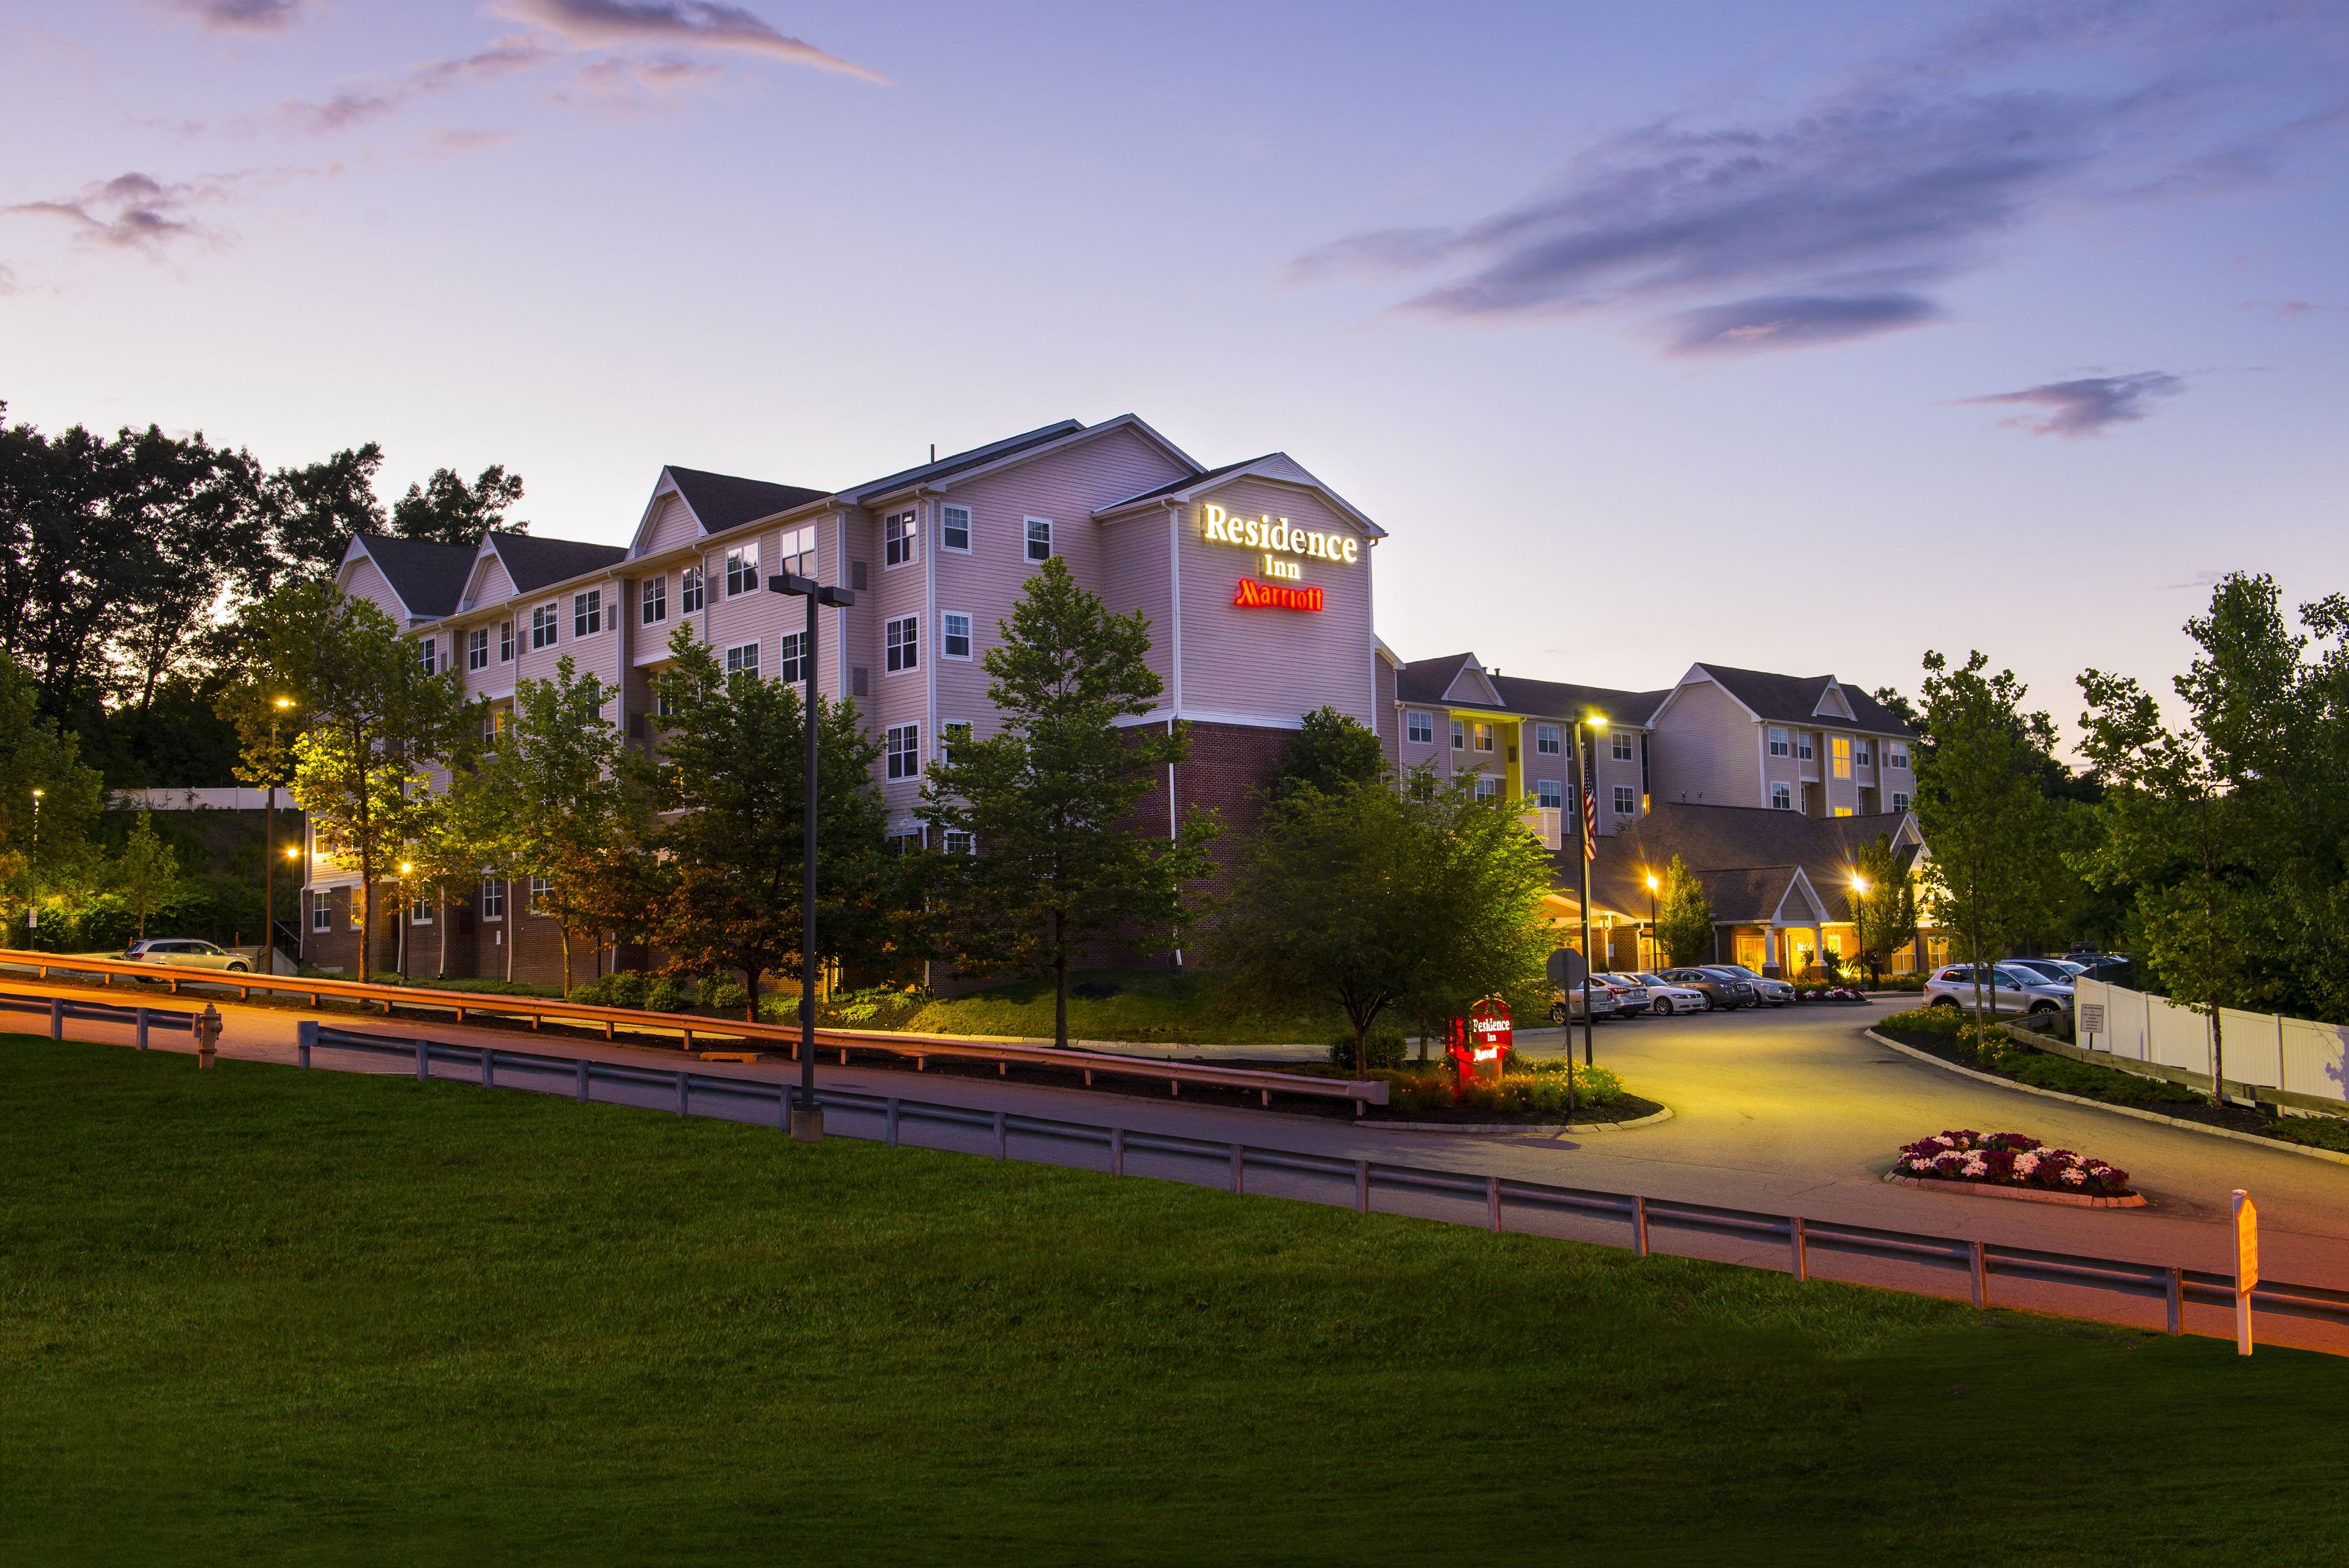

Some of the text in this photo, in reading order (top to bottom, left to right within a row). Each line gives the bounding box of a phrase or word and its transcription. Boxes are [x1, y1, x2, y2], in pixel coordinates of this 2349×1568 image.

[1205, 503, 1357, 562] Residence
[1264, 554, 1301, 579] Inn
[1234, 578, 1323, 611] Marriott
[1487, 1033, 1496, 1041] Inn
